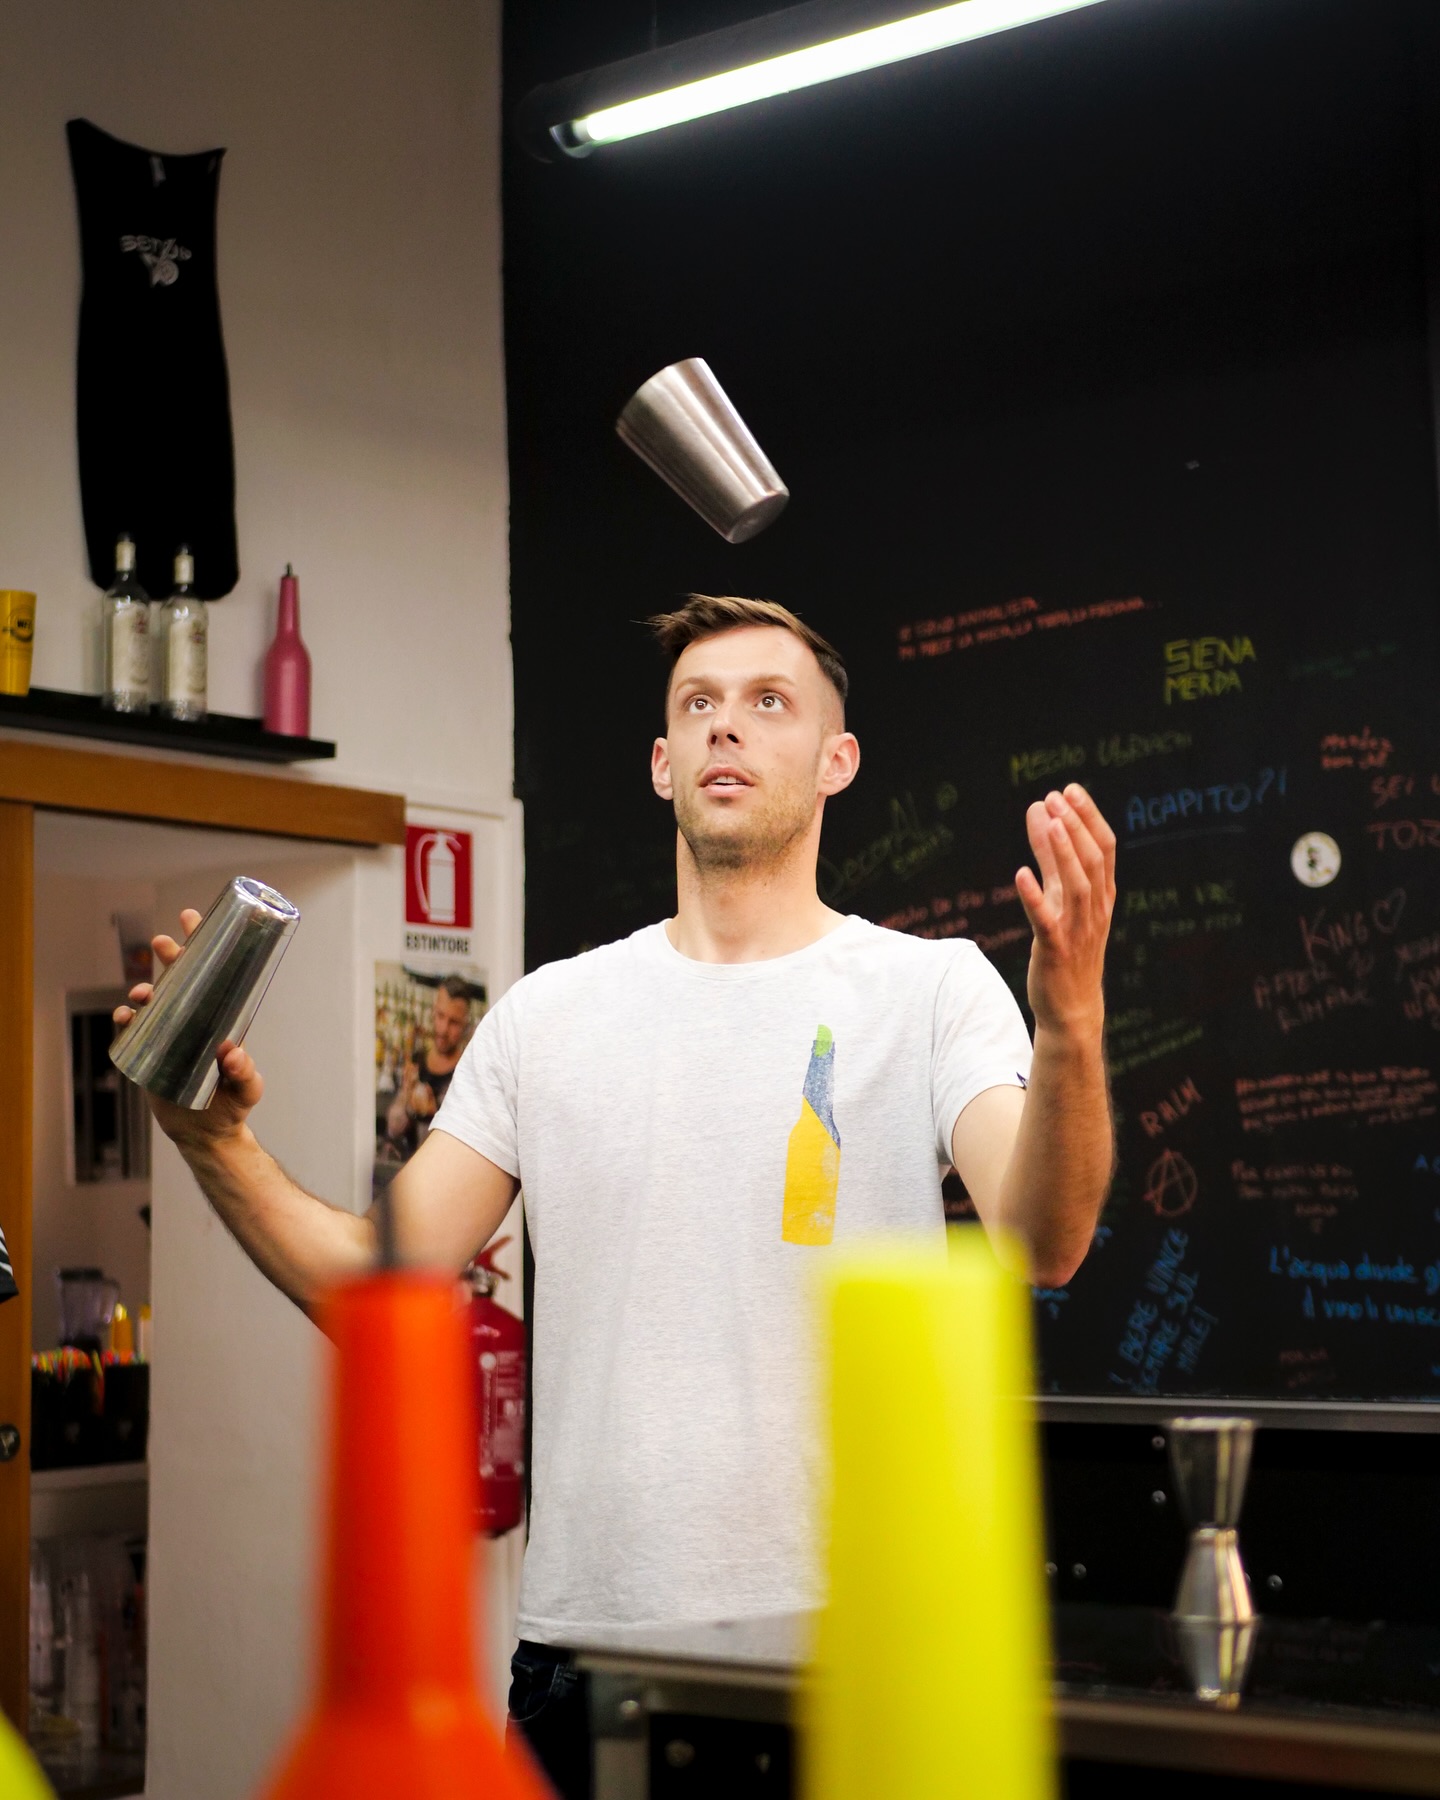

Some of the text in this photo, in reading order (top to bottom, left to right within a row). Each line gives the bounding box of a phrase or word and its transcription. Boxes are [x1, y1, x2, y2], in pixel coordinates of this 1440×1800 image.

[1164, 635, 1257, 675] SIENA
[1163, 667, 1243, 706] MERDA
[405, 931, 471, 955] ESTINTORE
[1146, 1227, 1190, 1296] VINCE
[1269, 1245, 1350, 1288] L'acqua
